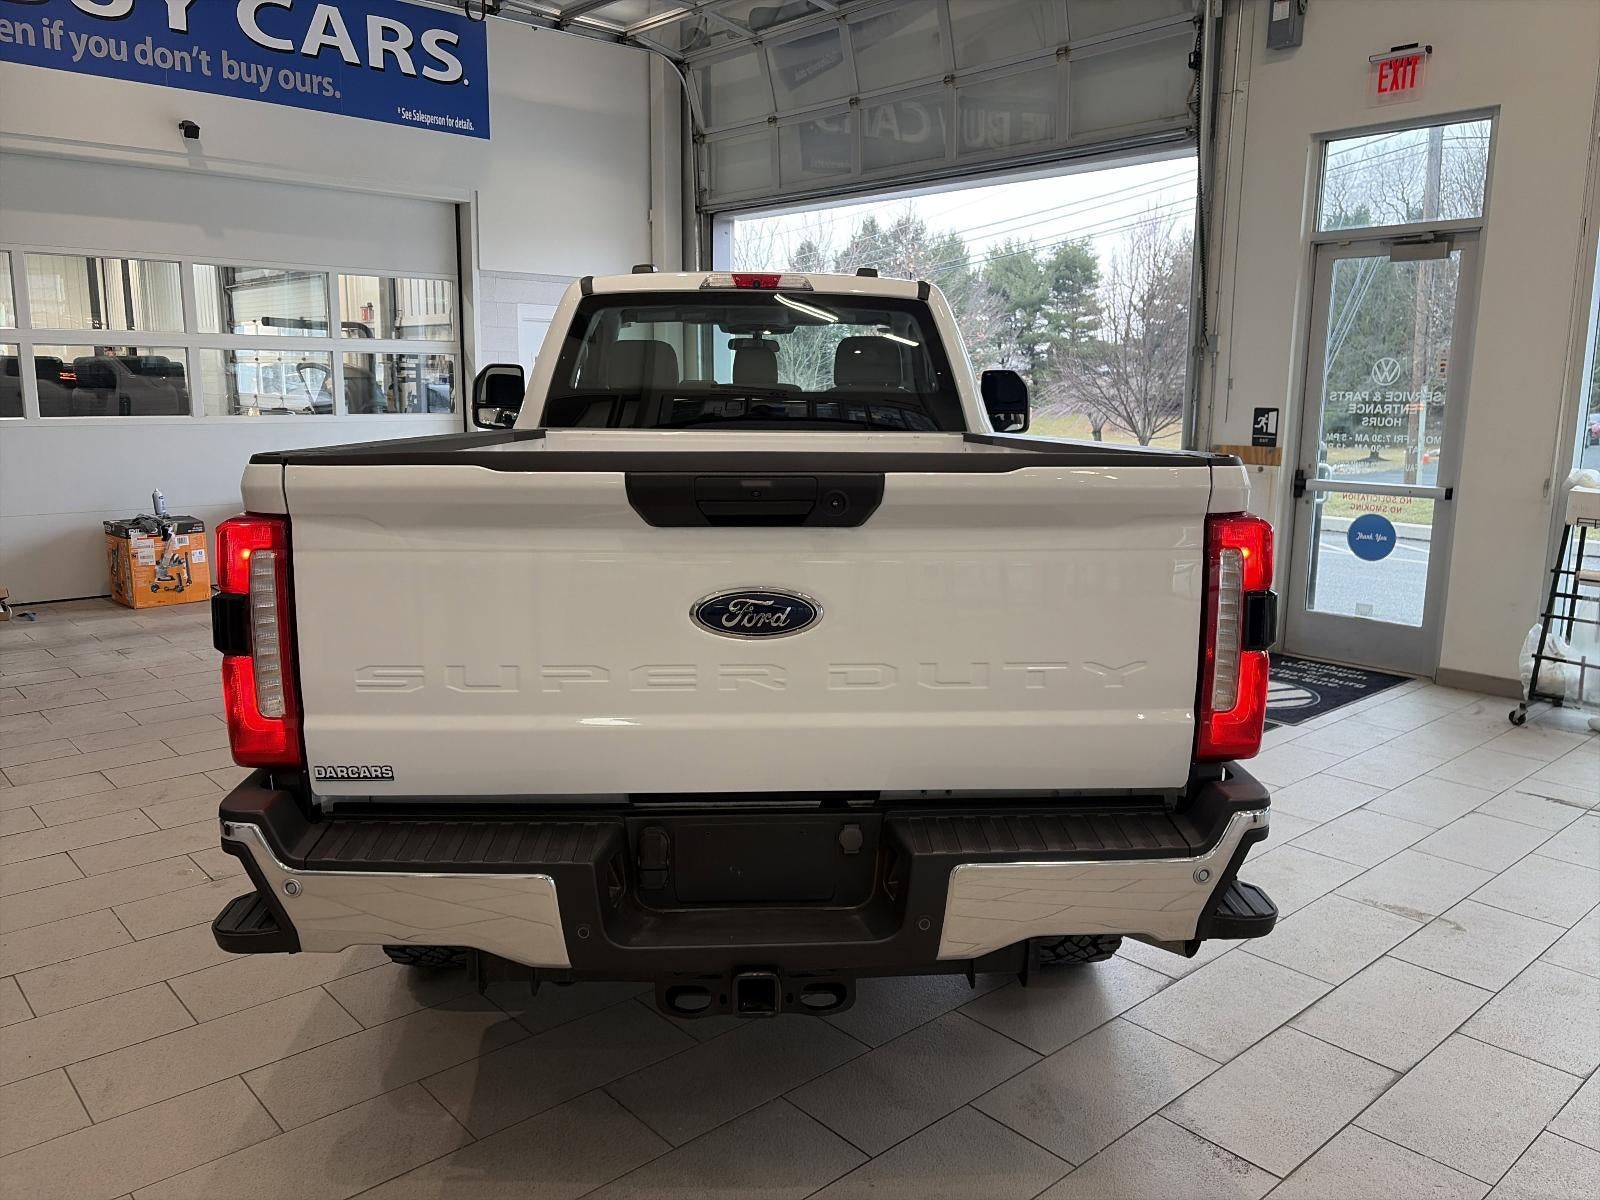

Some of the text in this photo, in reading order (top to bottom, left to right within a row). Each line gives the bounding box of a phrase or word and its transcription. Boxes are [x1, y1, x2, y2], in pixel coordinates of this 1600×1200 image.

[41, 17, 64, 50] if
[69, 31, 128, 62] you
[134, 36, 211, 76] don't
[221, 50, 272, 93] buy
[278, 69, 341, 98] ours.
[237, 0, 469, 86] CARS.
[1377, 55, 1420, 94] EXIT
[401, 107, 475, 131] See Salesperson for details.
[1355, 531, 1387, 543] Thank You
[721, 598, 792, 628] Ford
[355, 660, 1148, 693] SUPER DUTY
[314, 765, 394, 781] DARCARS
